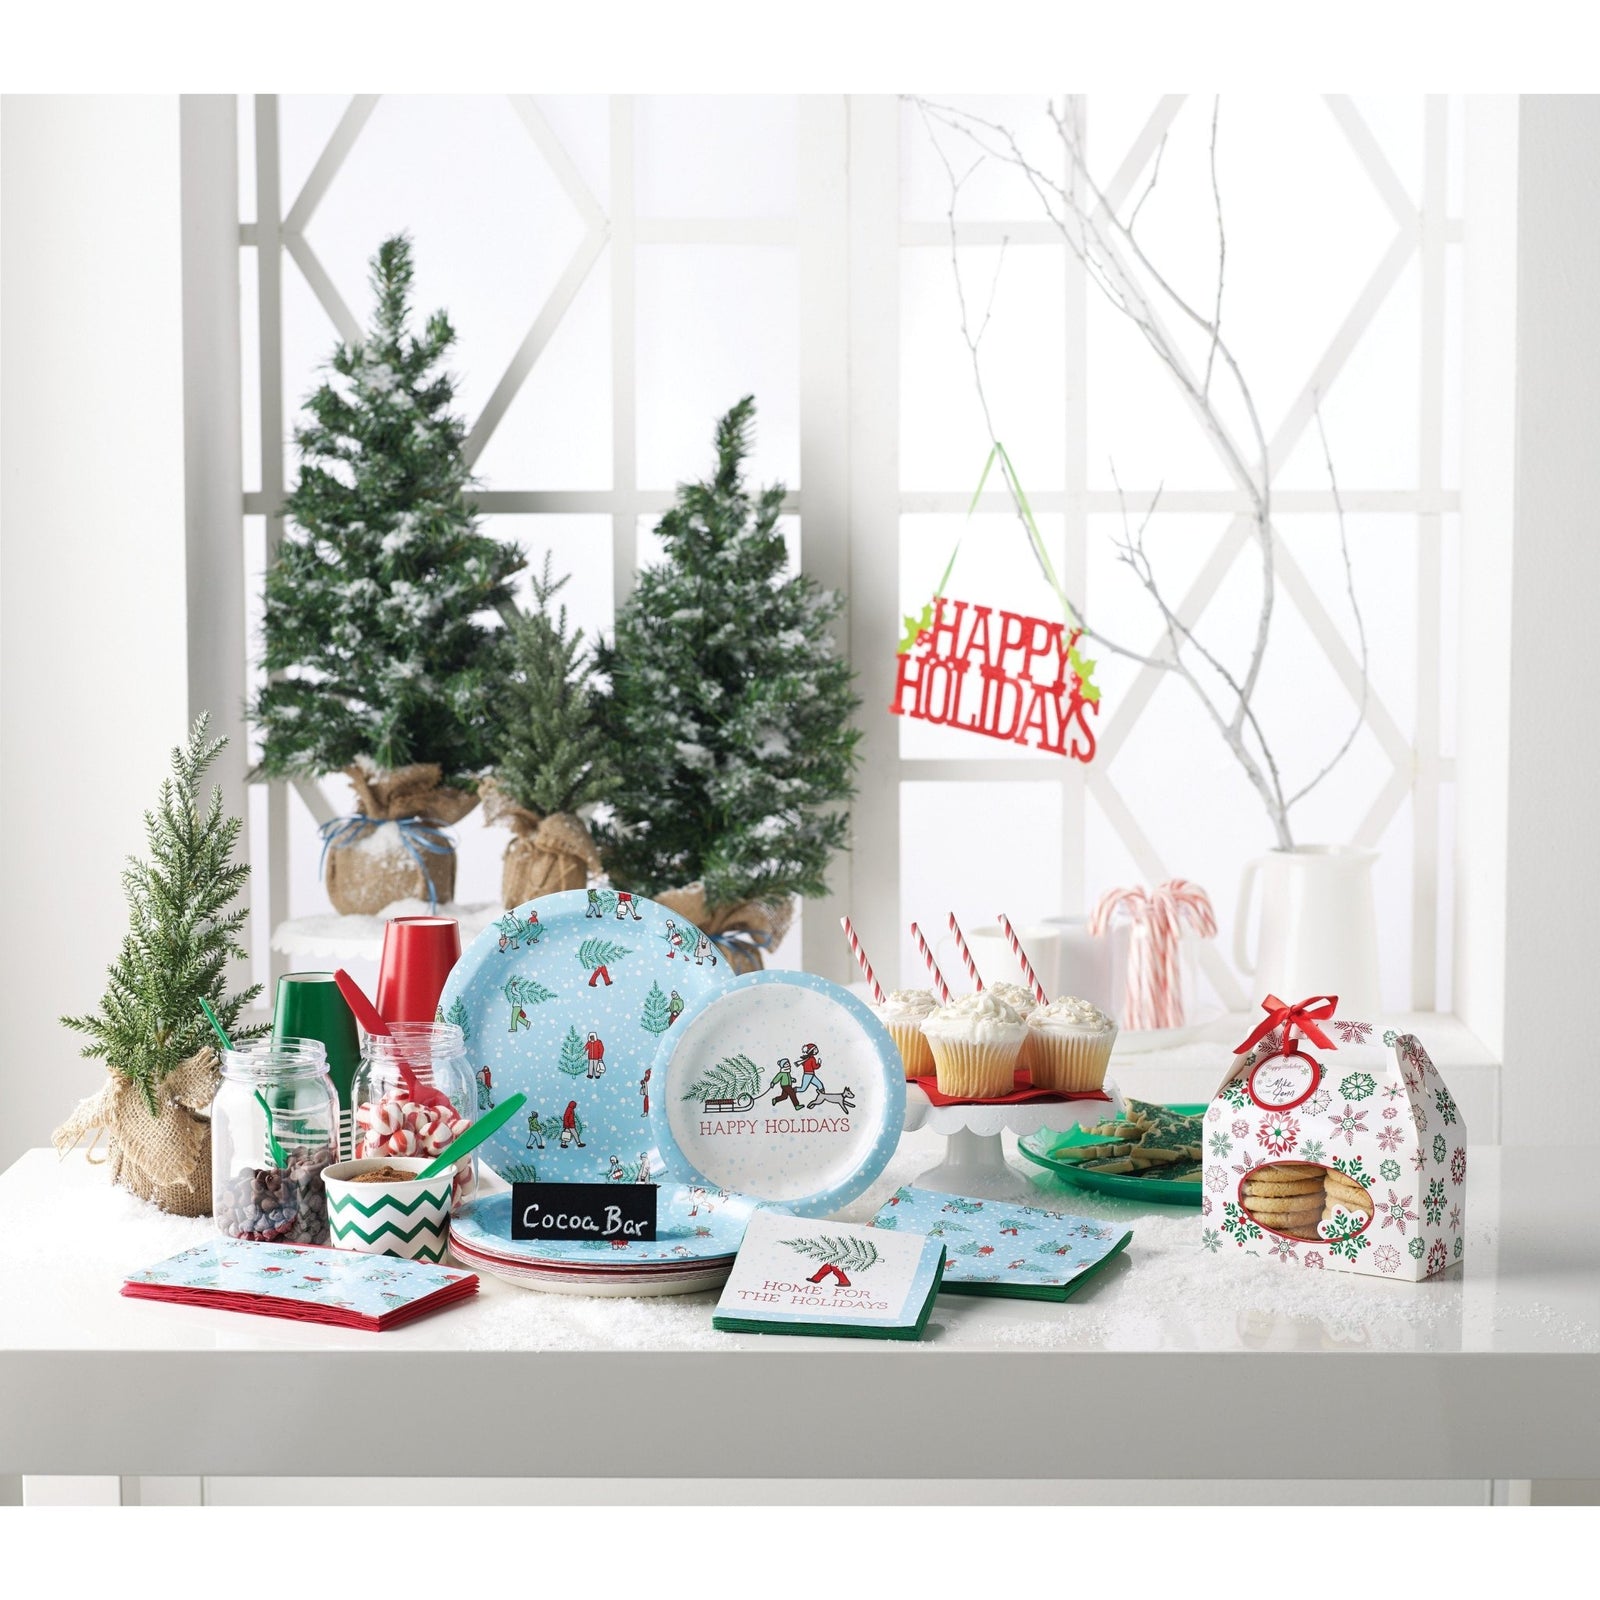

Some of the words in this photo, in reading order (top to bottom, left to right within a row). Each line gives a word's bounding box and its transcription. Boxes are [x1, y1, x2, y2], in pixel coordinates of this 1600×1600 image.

[926, 595, 1082, 692] HAPPY
[888, 653, 1100, 763] HOLIDAYS
[1266, 1077, 1295, 1088] Mike
[700, 1120, 757, 1136] HAPPY
[765, 1118, 850, 1134] HOLIDAYS
[523, 1203, 600, 1231] Cocoa
[601, 1205, 648, 1236] Bar
[762, 1280, 823, 1295] HOME
[833, 1288, 871, 1299] FOR
[738, 1290, 780, 1303] THE
[791, 1295, 888, 1310] HOLIDAYS
